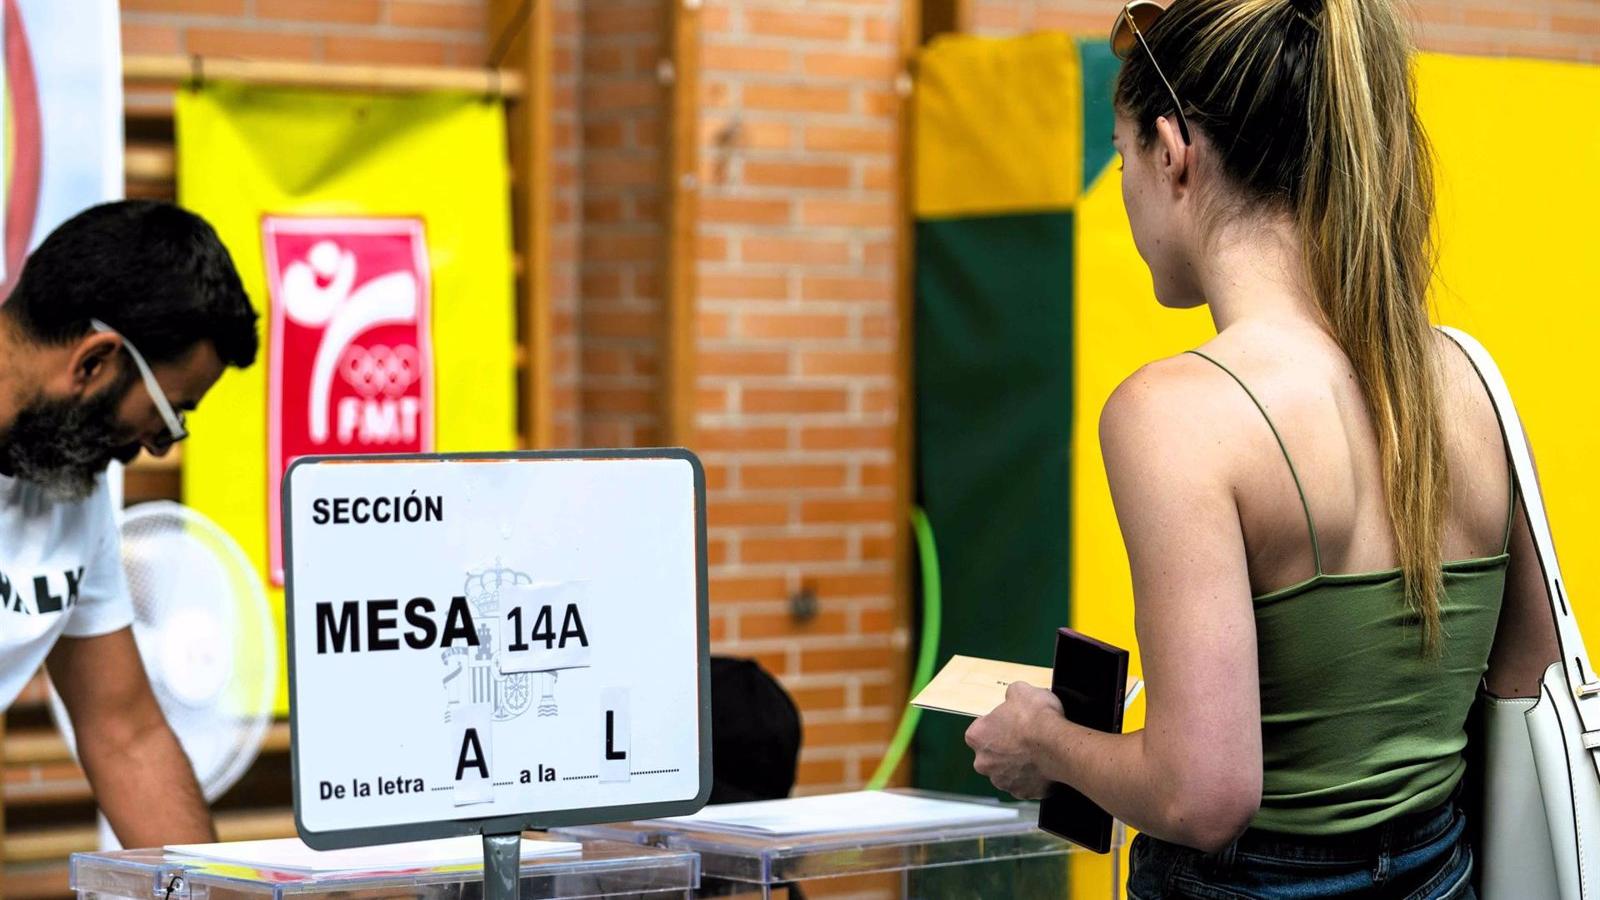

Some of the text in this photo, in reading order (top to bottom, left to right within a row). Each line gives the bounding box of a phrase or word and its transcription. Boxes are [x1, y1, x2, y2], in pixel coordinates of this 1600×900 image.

[338, 397, 419, 444] FMT
[312, 489, 443, 525] SECCIÓN
[316, 596, 589, 654] MESA 14A
[319, 710, 626, 800] De la letra A a la L
